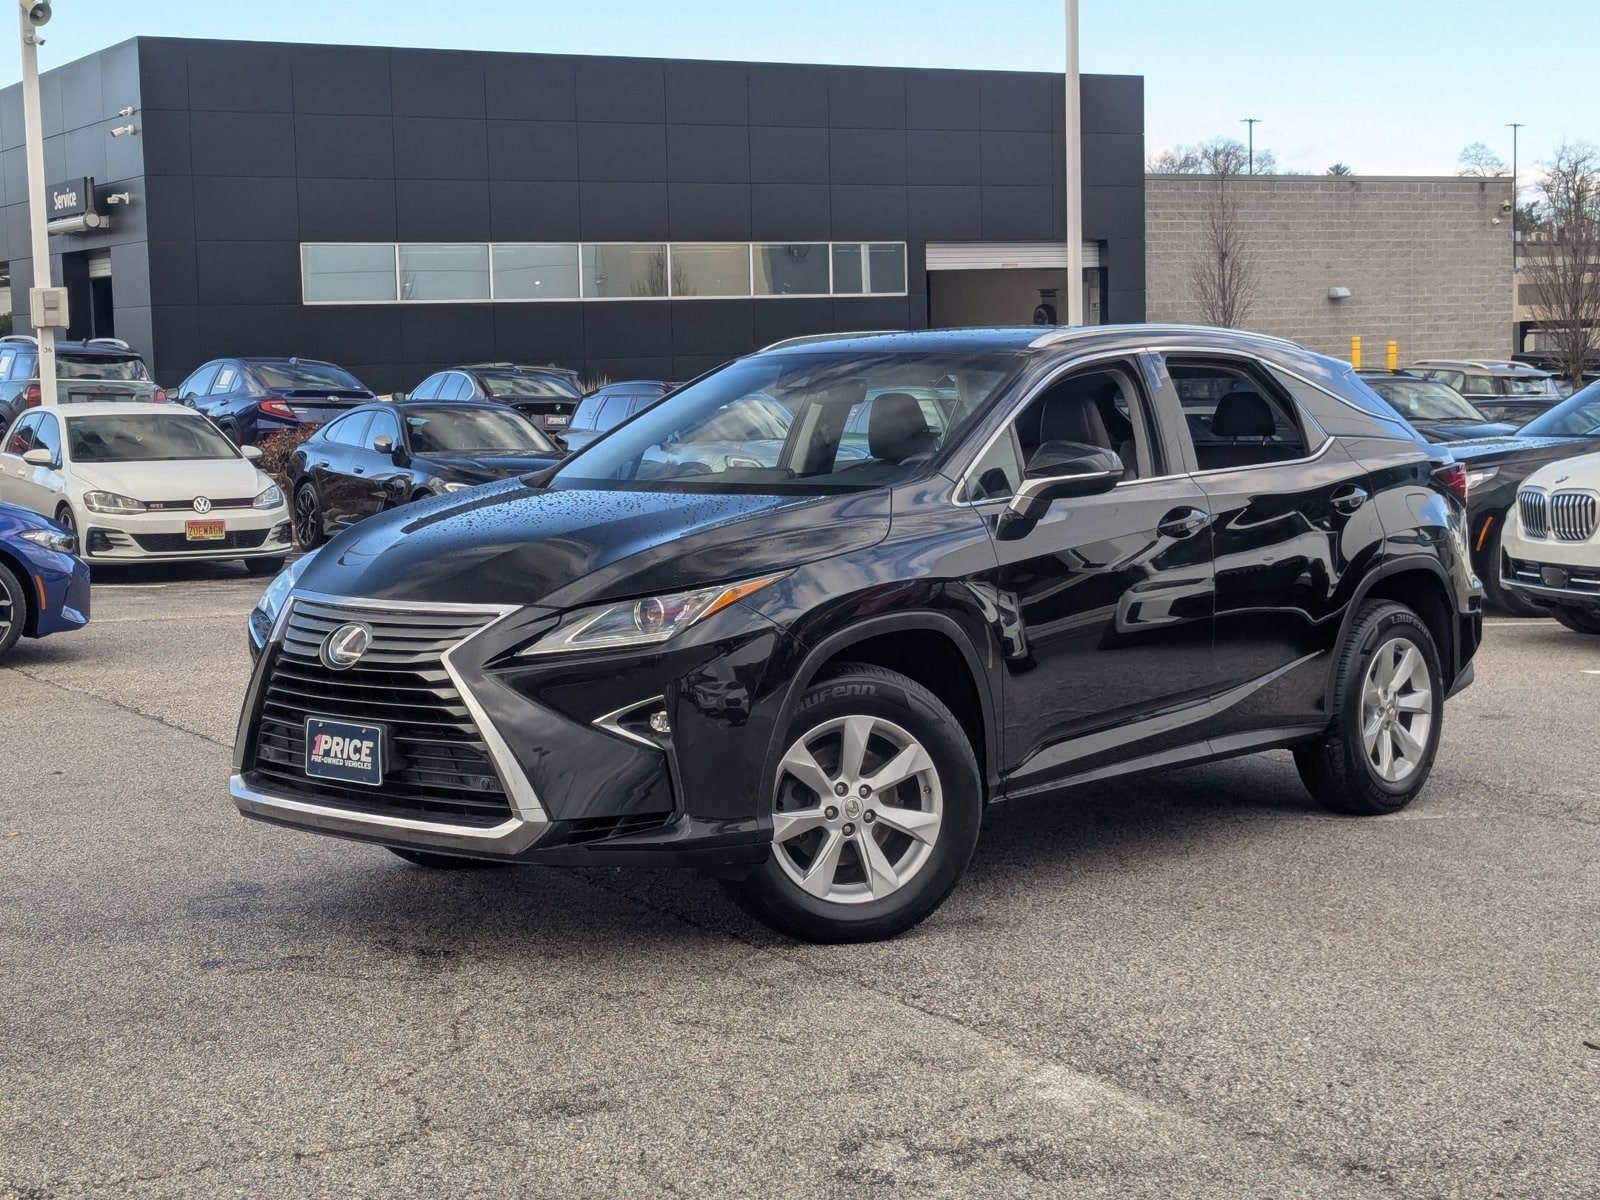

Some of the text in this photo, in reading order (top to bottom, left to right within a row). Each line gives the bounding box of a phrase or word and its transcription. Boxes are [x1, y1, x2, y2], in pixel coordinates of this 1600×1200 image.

[53, 187, 77, 210] Service
[793, 684, 877, 716] aufenn
[311, 754, 372, 770] PRE-OWNED VEHICLES
